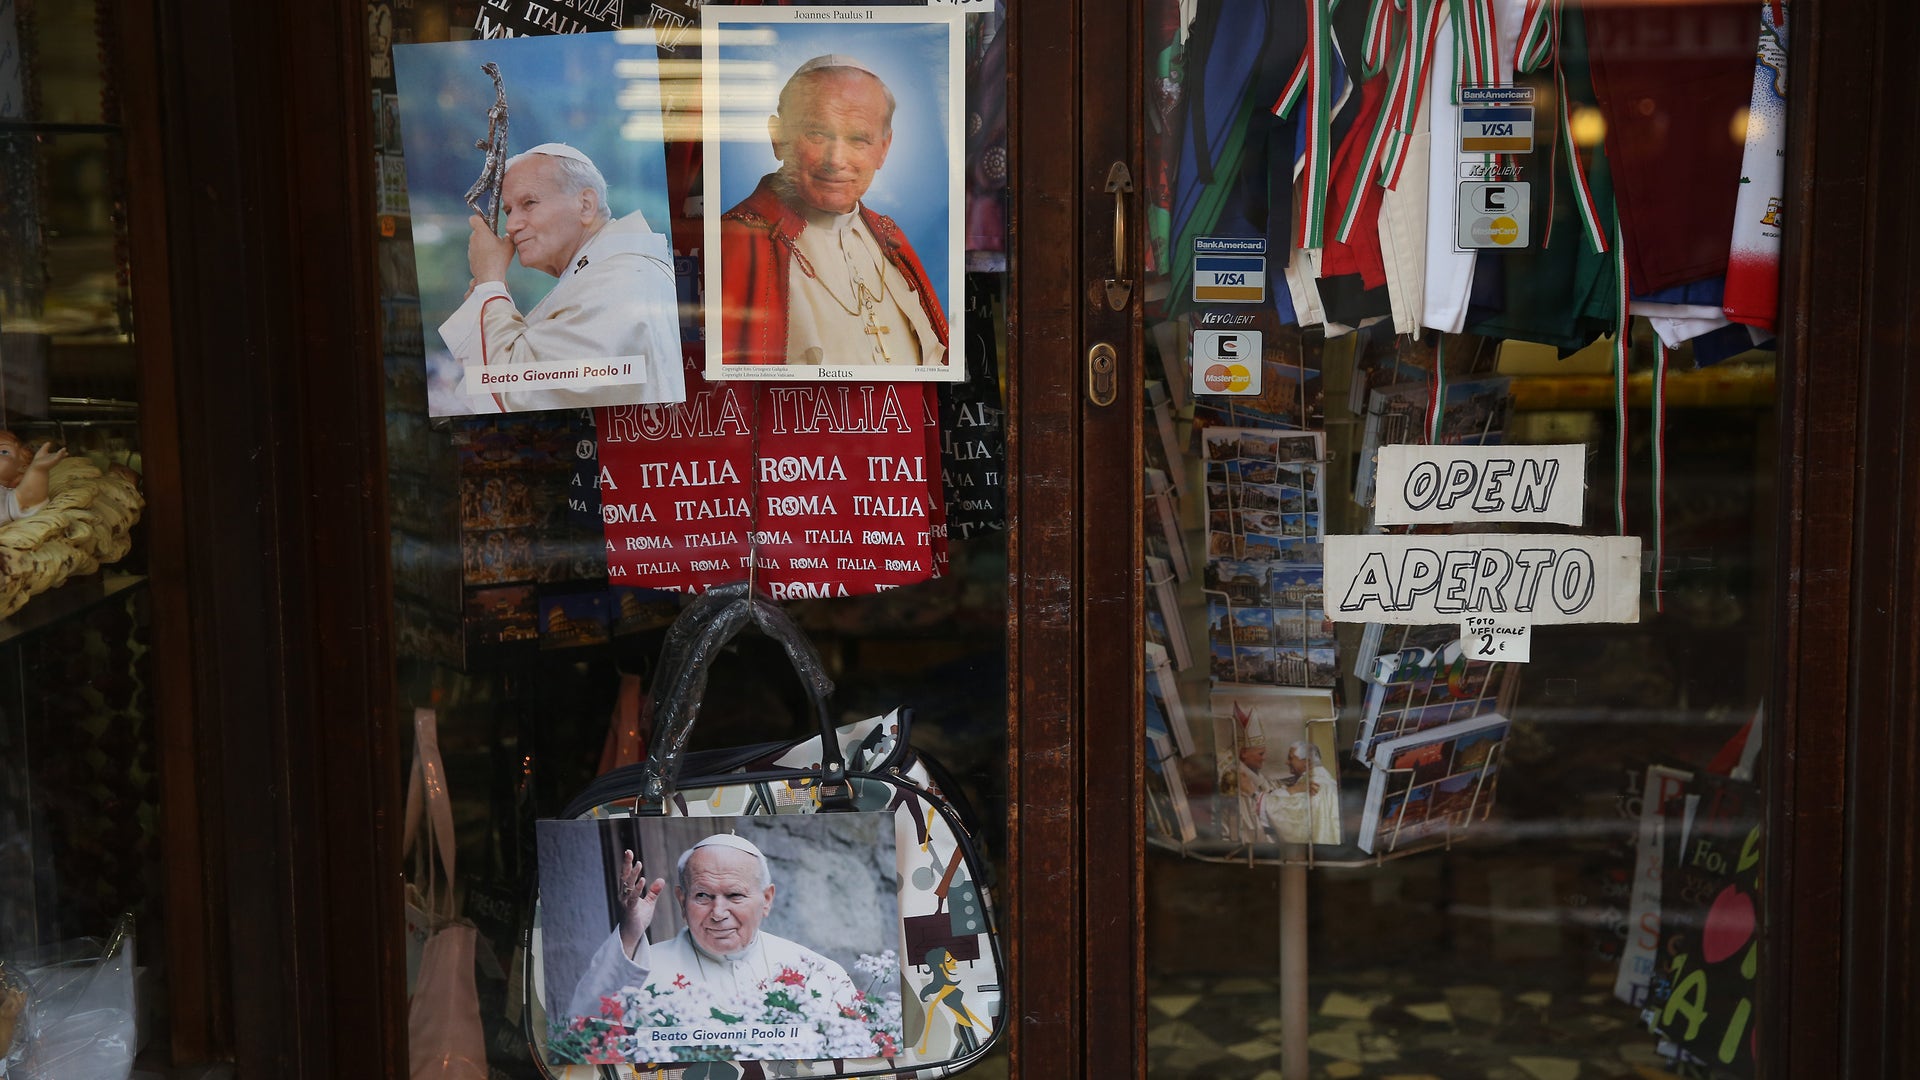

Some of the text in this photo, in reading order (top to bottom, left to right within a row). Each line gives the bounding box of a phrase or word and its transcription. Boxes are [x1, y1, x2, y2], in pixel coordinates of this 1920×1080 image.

[794, 10, 873, 19] Joannes Paulus II
[1481, 123, 1513, 136] VISA
[1214, 273, 1245, 286] VISA
[481, 363, 631, 384] Beato Giovanni Paolo II
[818, 368, 853, 378] Beatus
[1205, 374, 1249, 383] MasterCard
[607, 388, 750, 442] ROMA
[770, 384, 911, 434] ITALIA
[640, 459, 741, 488] ITALIA
[759, 456, 847, 482] ROMA
[1403, 458, 1559, 513] OPEN
[602, 502, 657, 524] OMA
[674, 497, 751, 521] ITALIA
[767, 495, 837, 517] ROMA
[853, 495, 925, 517] ITALIA
[625, 535, 673, 551] ROMA
[684, 531, 738, 548] ITALIA
[804, 529, 854, 544] ITALIA
[862, 530, 905, 546] ROMA
[636, 562, 681, 576] ITALIA
[690, 559, 730, 572] ROMA
[789, 557, 829, 569] ROMA
[837, 557, 877, 570] ITALIA
[885, 559, 922, 572] ROMA
[1340, 548, 1596, 614] APERTO
[1465, 616, 1495, 626] FOTO
[1478, 634, 1496, 655] 2
[652, 1027, 798, 1041] Beato Giovanni Paolo II
